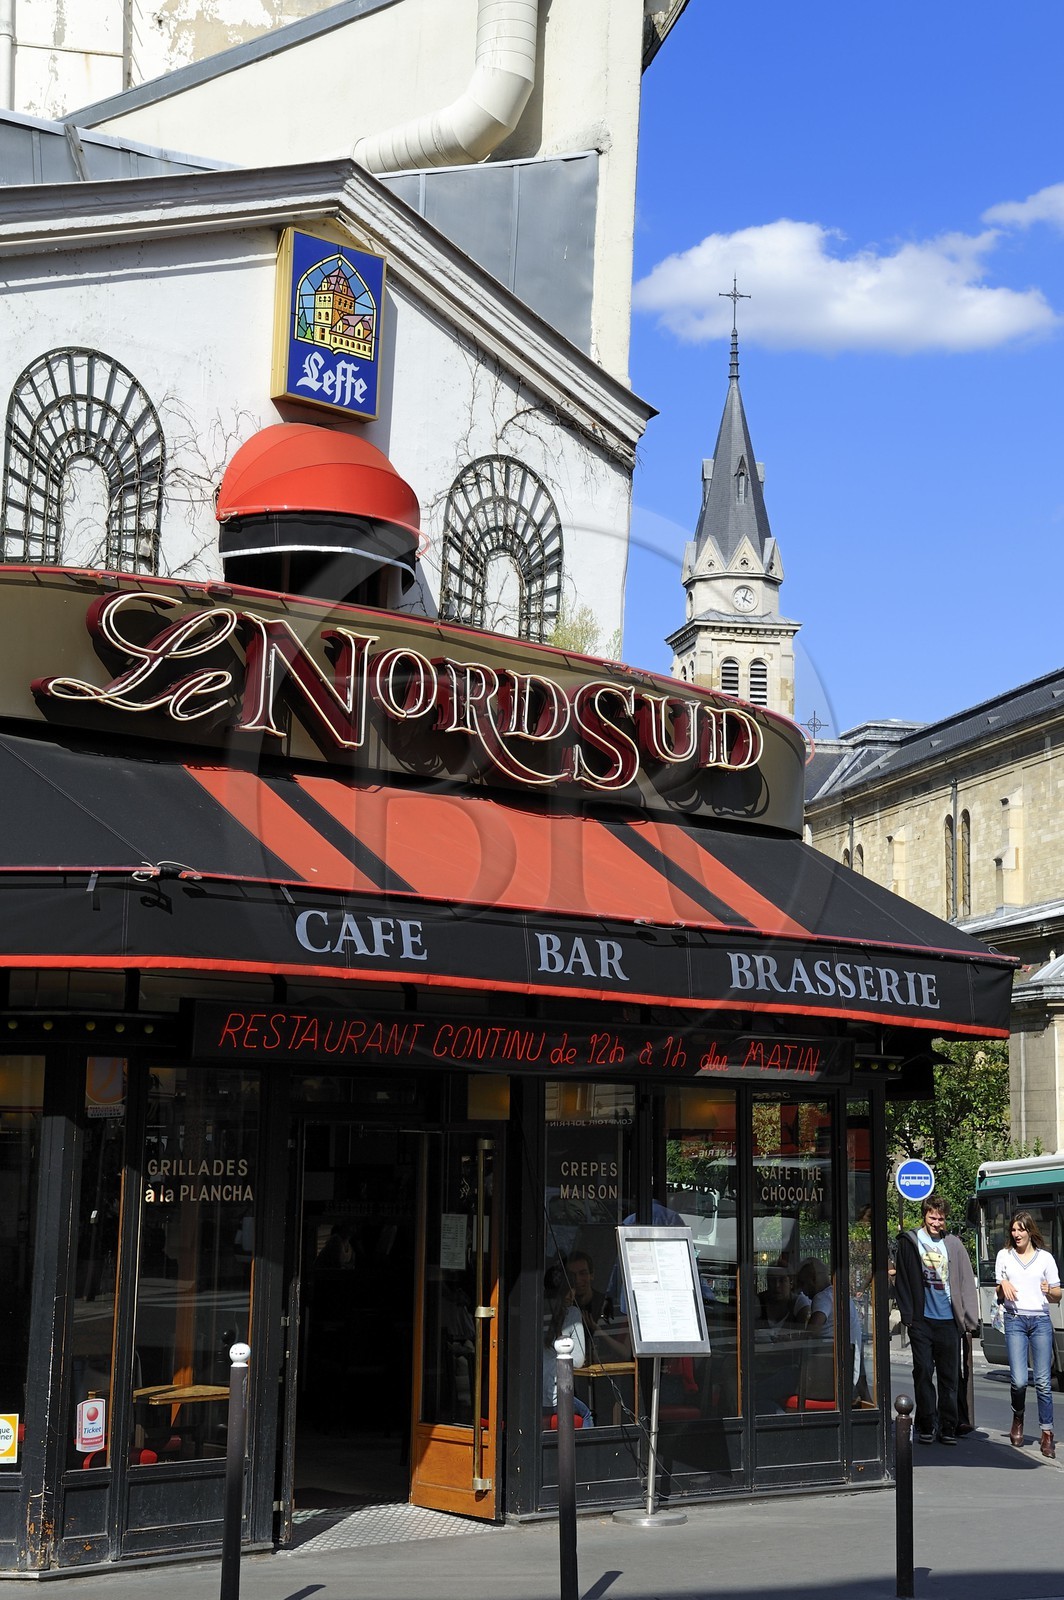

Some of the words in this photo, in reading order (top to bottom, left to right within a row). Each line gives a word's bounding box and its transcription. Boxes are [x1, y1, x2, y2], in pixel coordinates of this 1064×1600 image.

[295, 351, 368, 406] Leffe
[295, 910, 428, 961] CAFE
[534, 932, 630, 982] BAR
[726, 951, 941, 1010] BRASSERIE
[218, 1012, 426, 1056] RESTAURANT
[432, 1023, 547, 1062] CONTINU
[550, 1033, 578, 1065] de
[586, 1032, 625, 1065] 12h
[638, 1041, 653, 1066] à
[662, 1036, 687, 1068] 1h
[700, 1041, 729, 1072] du
[741, 1041, 821, 1077] MATIN
[147, 1159, 249, 1176] GRILLADES
[560, 1161, 618, 1177] CREPES
[145, 1184, 155, 1203] à
[159, 1185, 174, 1203] la
[180, 1185, 254, 1201] PLANCHA
[560, 1184, 618, 1200] MAISON
[761, 1187, 824, 1202] CHOCOLAT
[83, 1426, 102, 1434] Ticket
